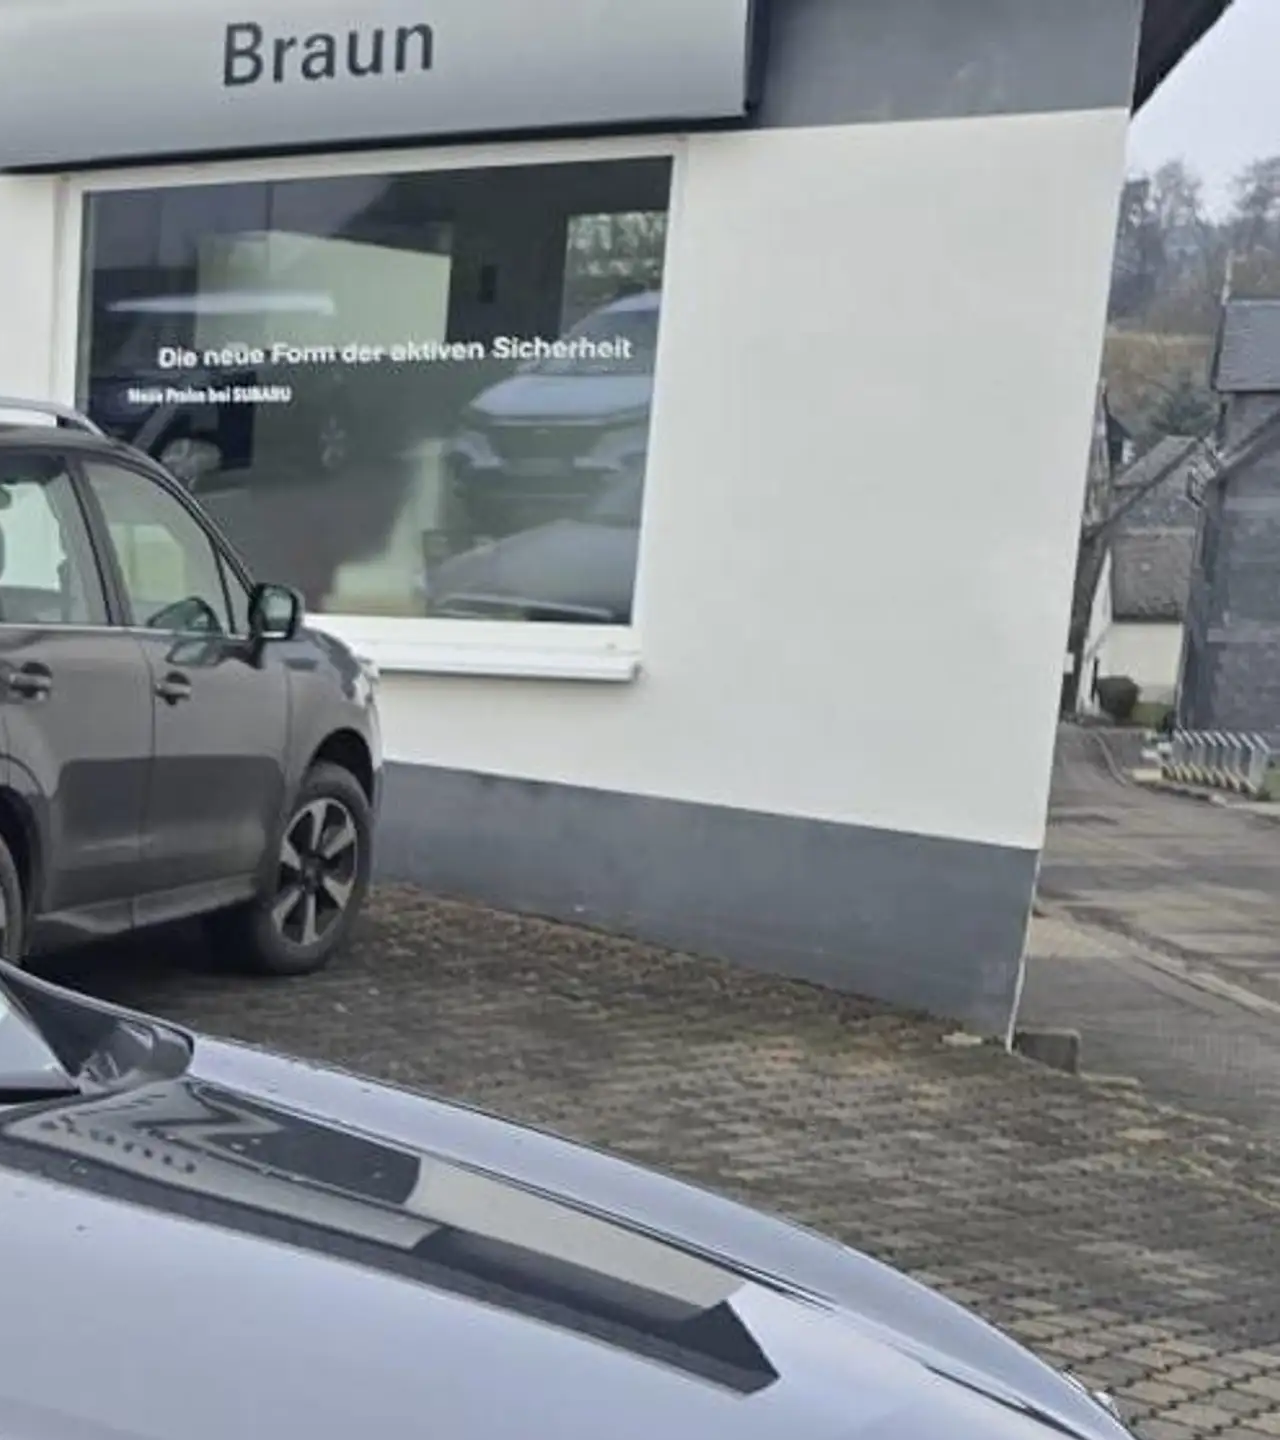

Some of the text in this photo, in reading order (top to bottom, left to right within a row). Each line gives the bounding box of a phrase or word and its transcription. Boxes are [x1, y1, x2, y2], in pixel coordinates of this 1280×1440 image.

[223, 22, 433, 86] Braun
[158, 335, 632, 368] Die neue Form der aktiven Sicherheit
